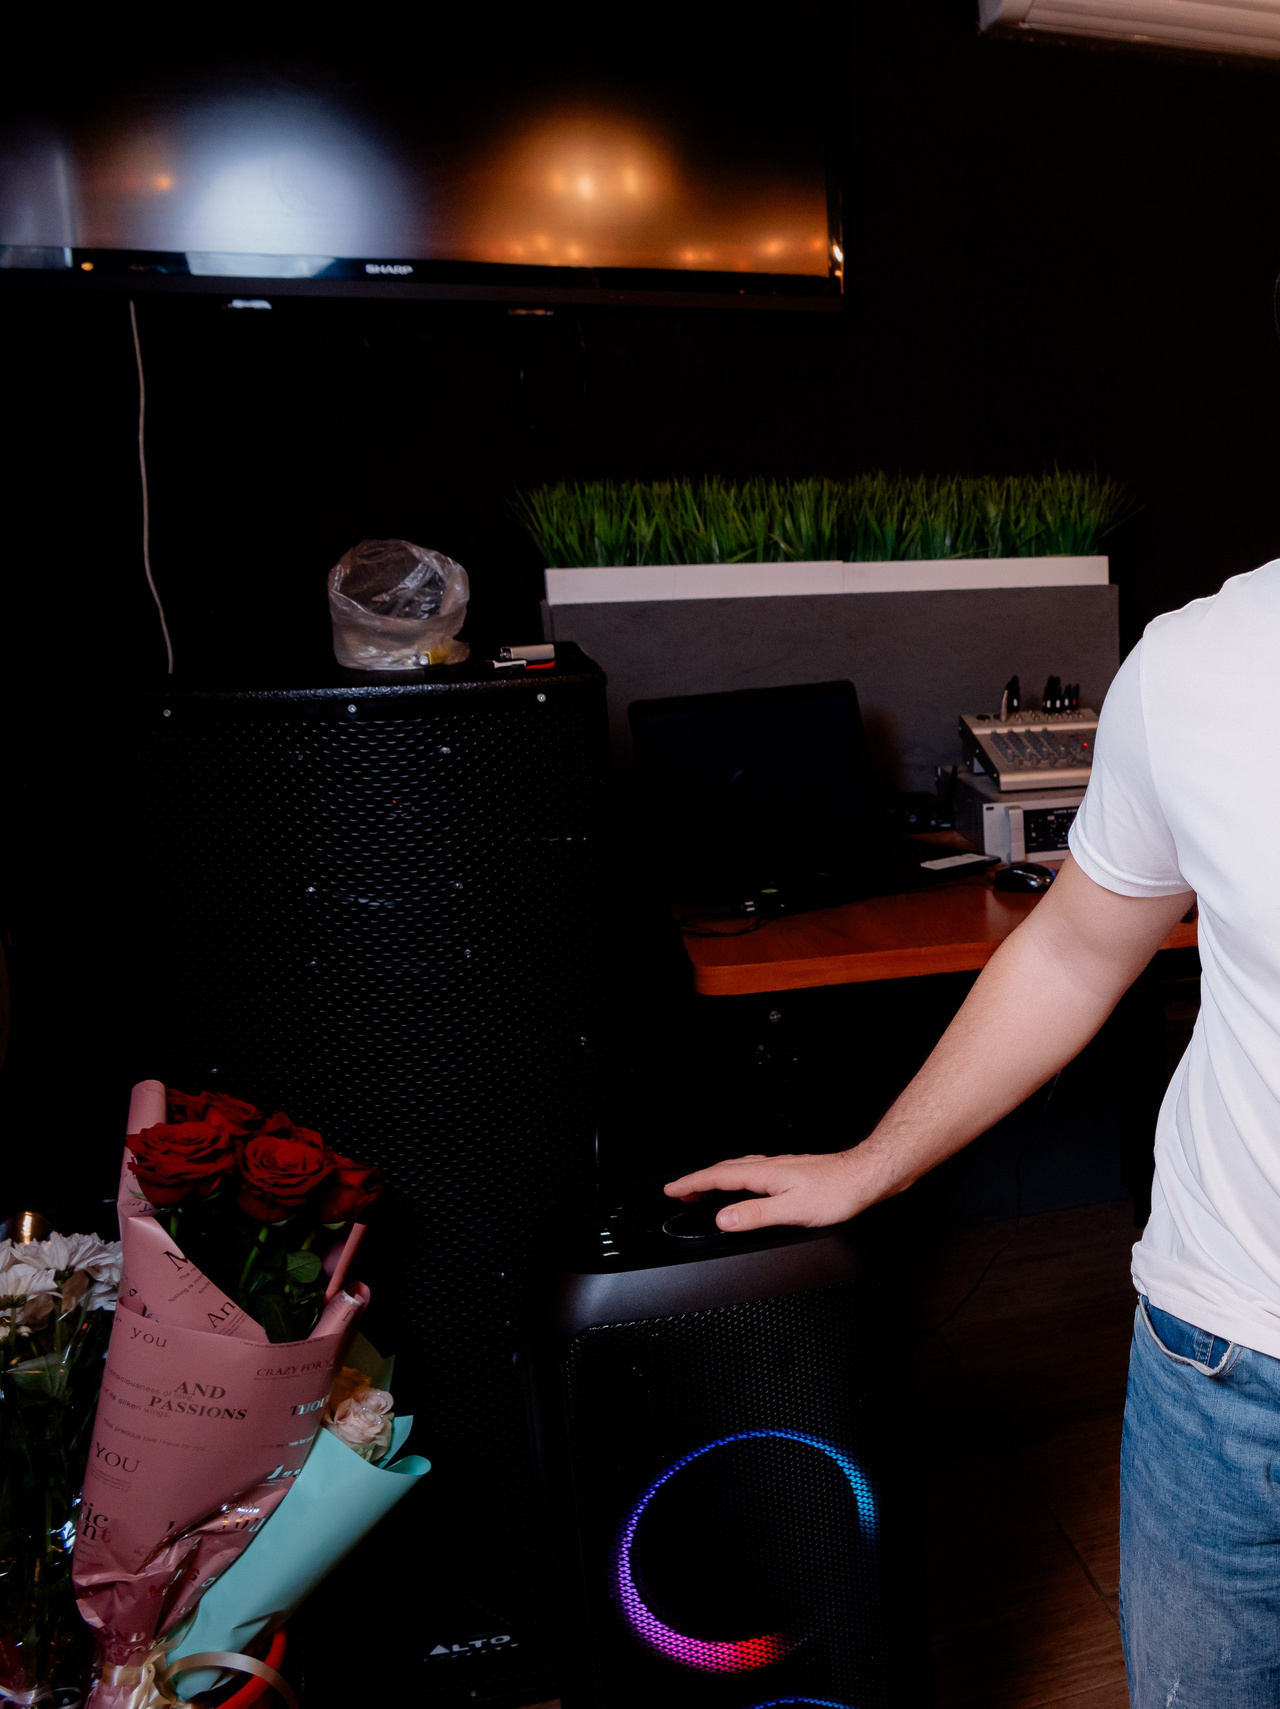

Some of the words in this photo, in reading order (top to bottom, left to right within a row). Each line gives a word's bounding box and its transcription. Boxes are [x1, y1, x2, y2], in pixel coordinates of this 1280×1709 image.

[364, 263, 414, 276] SHARP
[130, 1327, 168, 1348] you
[256, 1366, 300, 1377] CRAZY
[301, 1360, 322, 1373] FOR
[174, 1380, 227, 1400] AND
[149, 1396, 248, 1421] PASSIONS
[95, 1441, 141, 1473] YOU
[429, 1634, 511, 1656] ALTO
